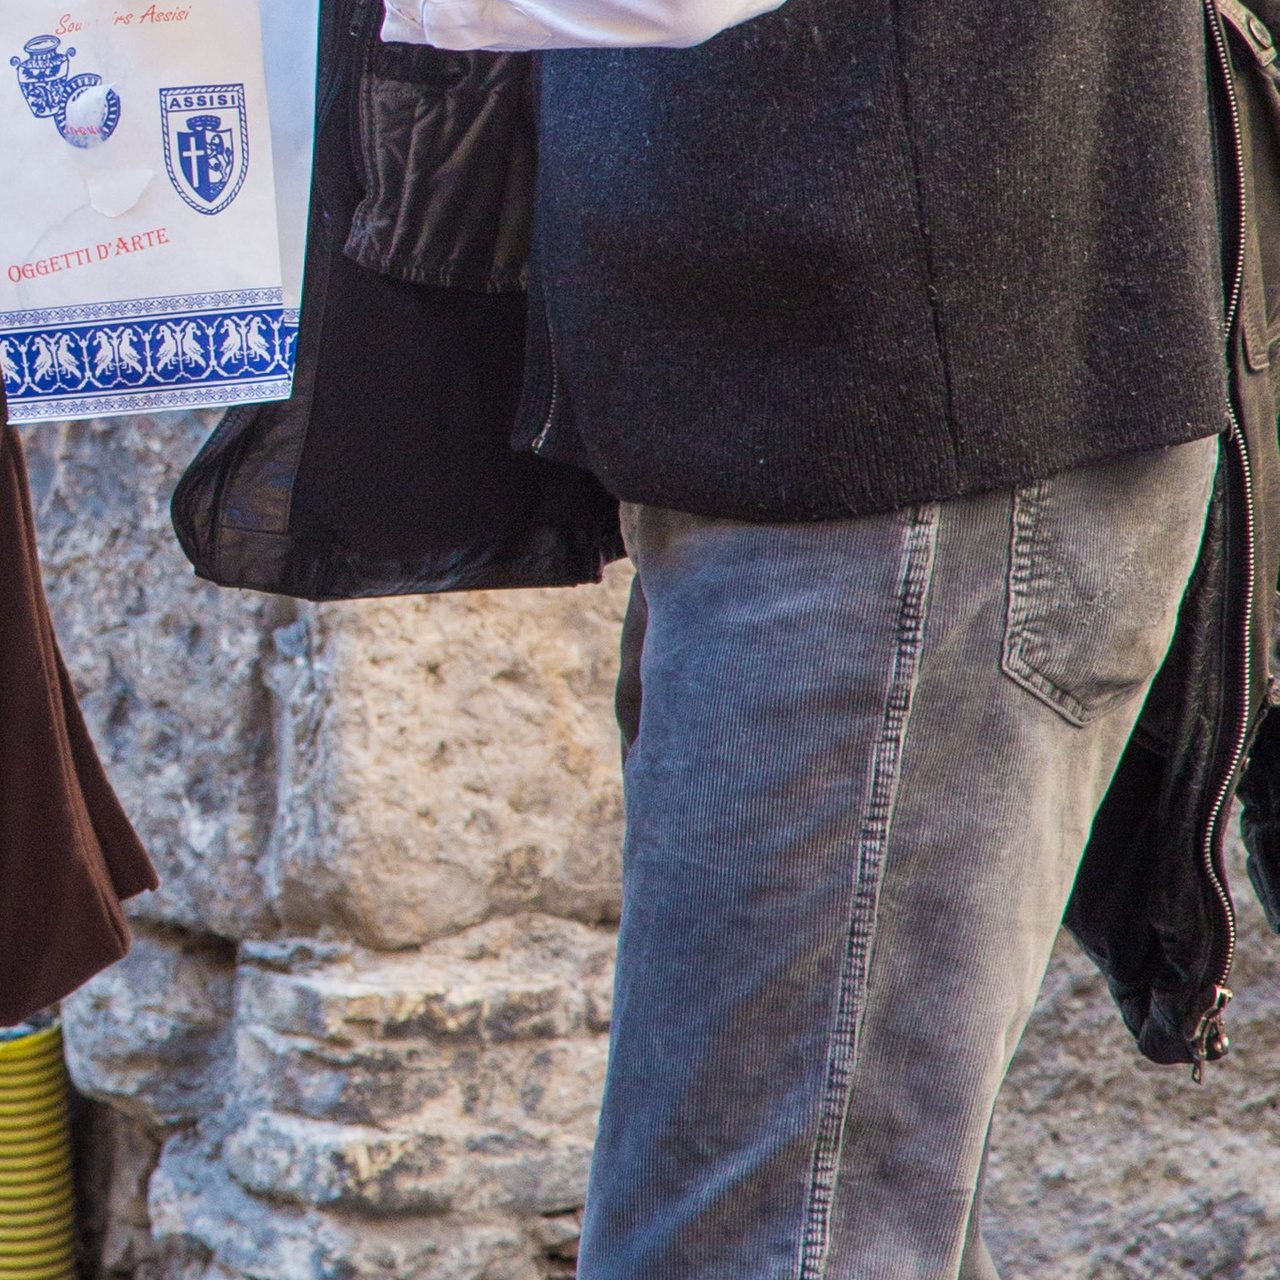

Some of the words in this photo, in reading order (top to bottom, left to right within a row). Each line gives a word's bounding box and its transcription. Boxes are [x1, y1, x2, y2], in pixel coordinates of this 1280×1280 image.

[55, 11, 134, 35] Souirs
[139, 4, 193, 24] Assisi
[169, 94, 235, 109] ASSISI
[7, 248, 92, 283] OGGETTI
[96, 227, 170, 260] D'ARTE
